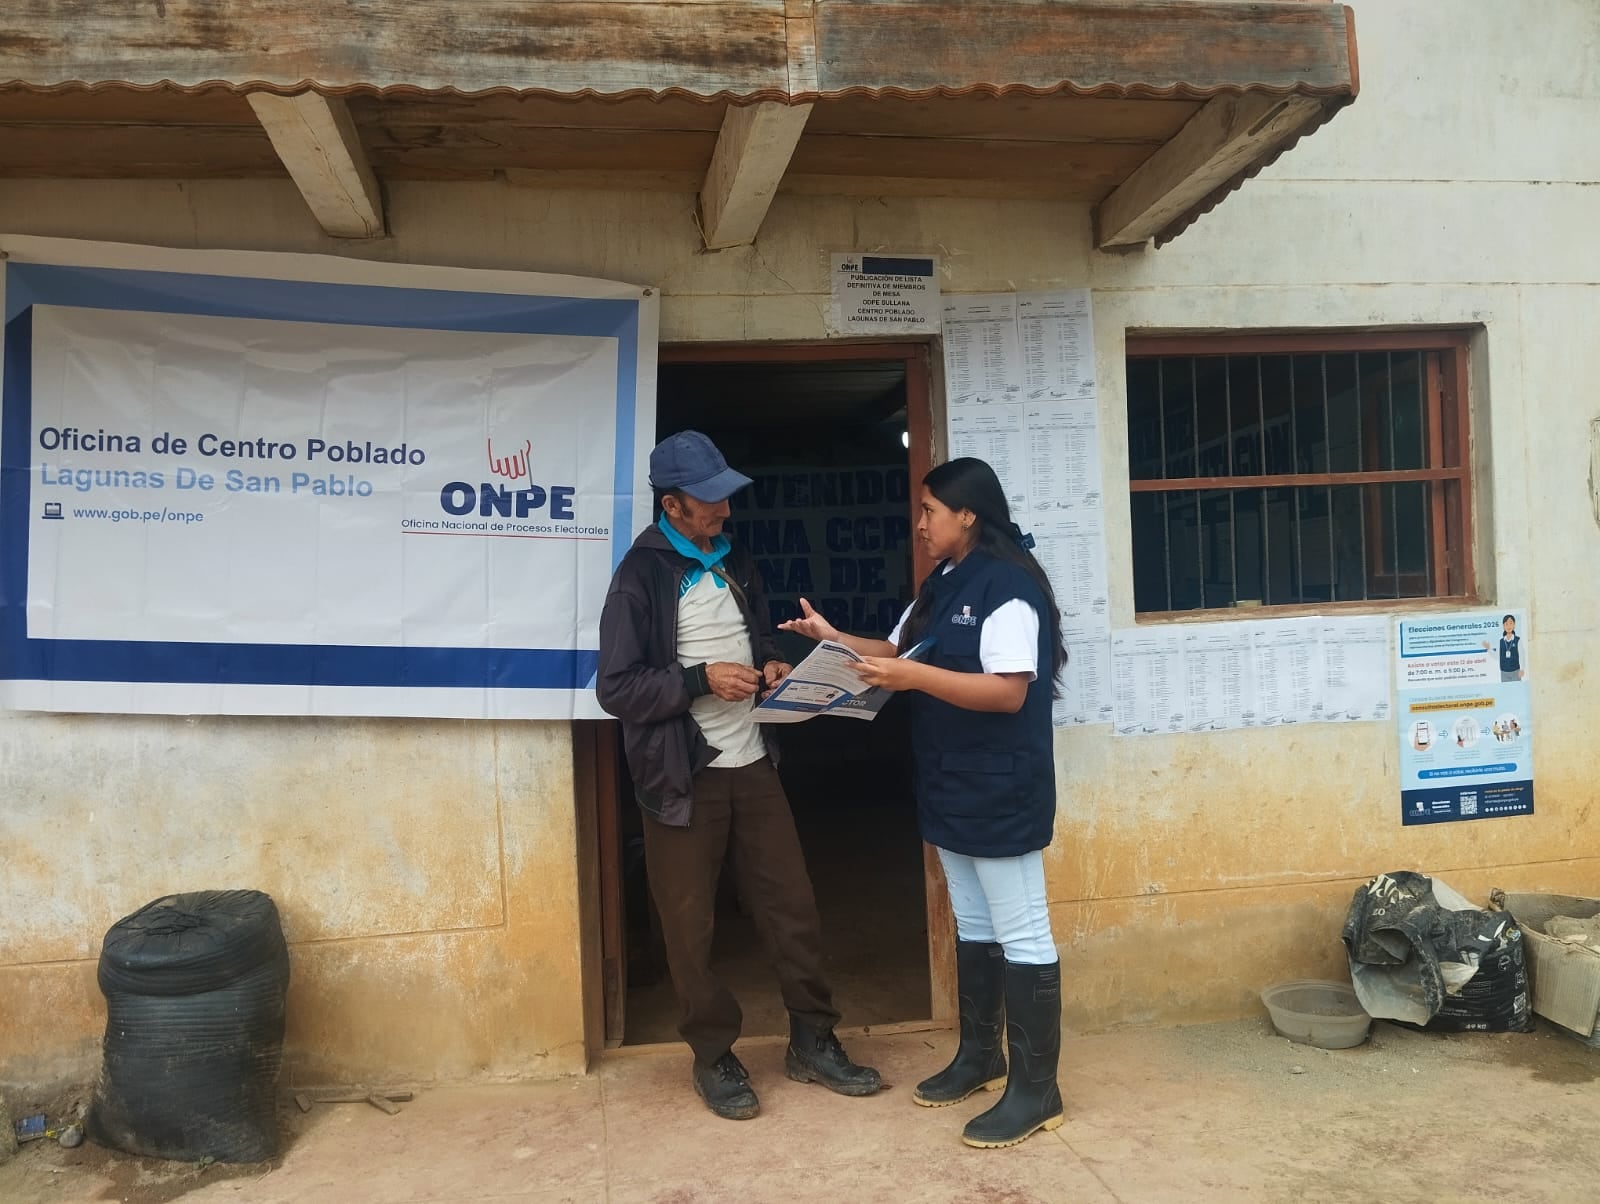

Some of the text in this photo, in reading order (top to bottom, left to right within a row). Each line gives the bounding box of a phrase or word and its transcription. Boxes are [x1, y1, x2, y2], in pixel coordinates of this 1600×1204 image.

[39, 427, 426, 466] Oficina de Centro Poblado
[41, 462, 373, 497] Lagunas De San Pablo
[73, 507, 204, 524] www.gob.pe/onpe
[440, 481, 576, 520] ONPE
[401, 519, 609, 535] Oficina Nacional de Procesos Electorales
[736, 519, 811, 554] INA
[760, 556, 887, 593] NA DE
[768, 597, 904, 634] PBLO
[952, 614, 978, 626] ONPE
[1408, 625, 1445, 633] Elecciones
[1446, 622, 1482, 630] Generales
